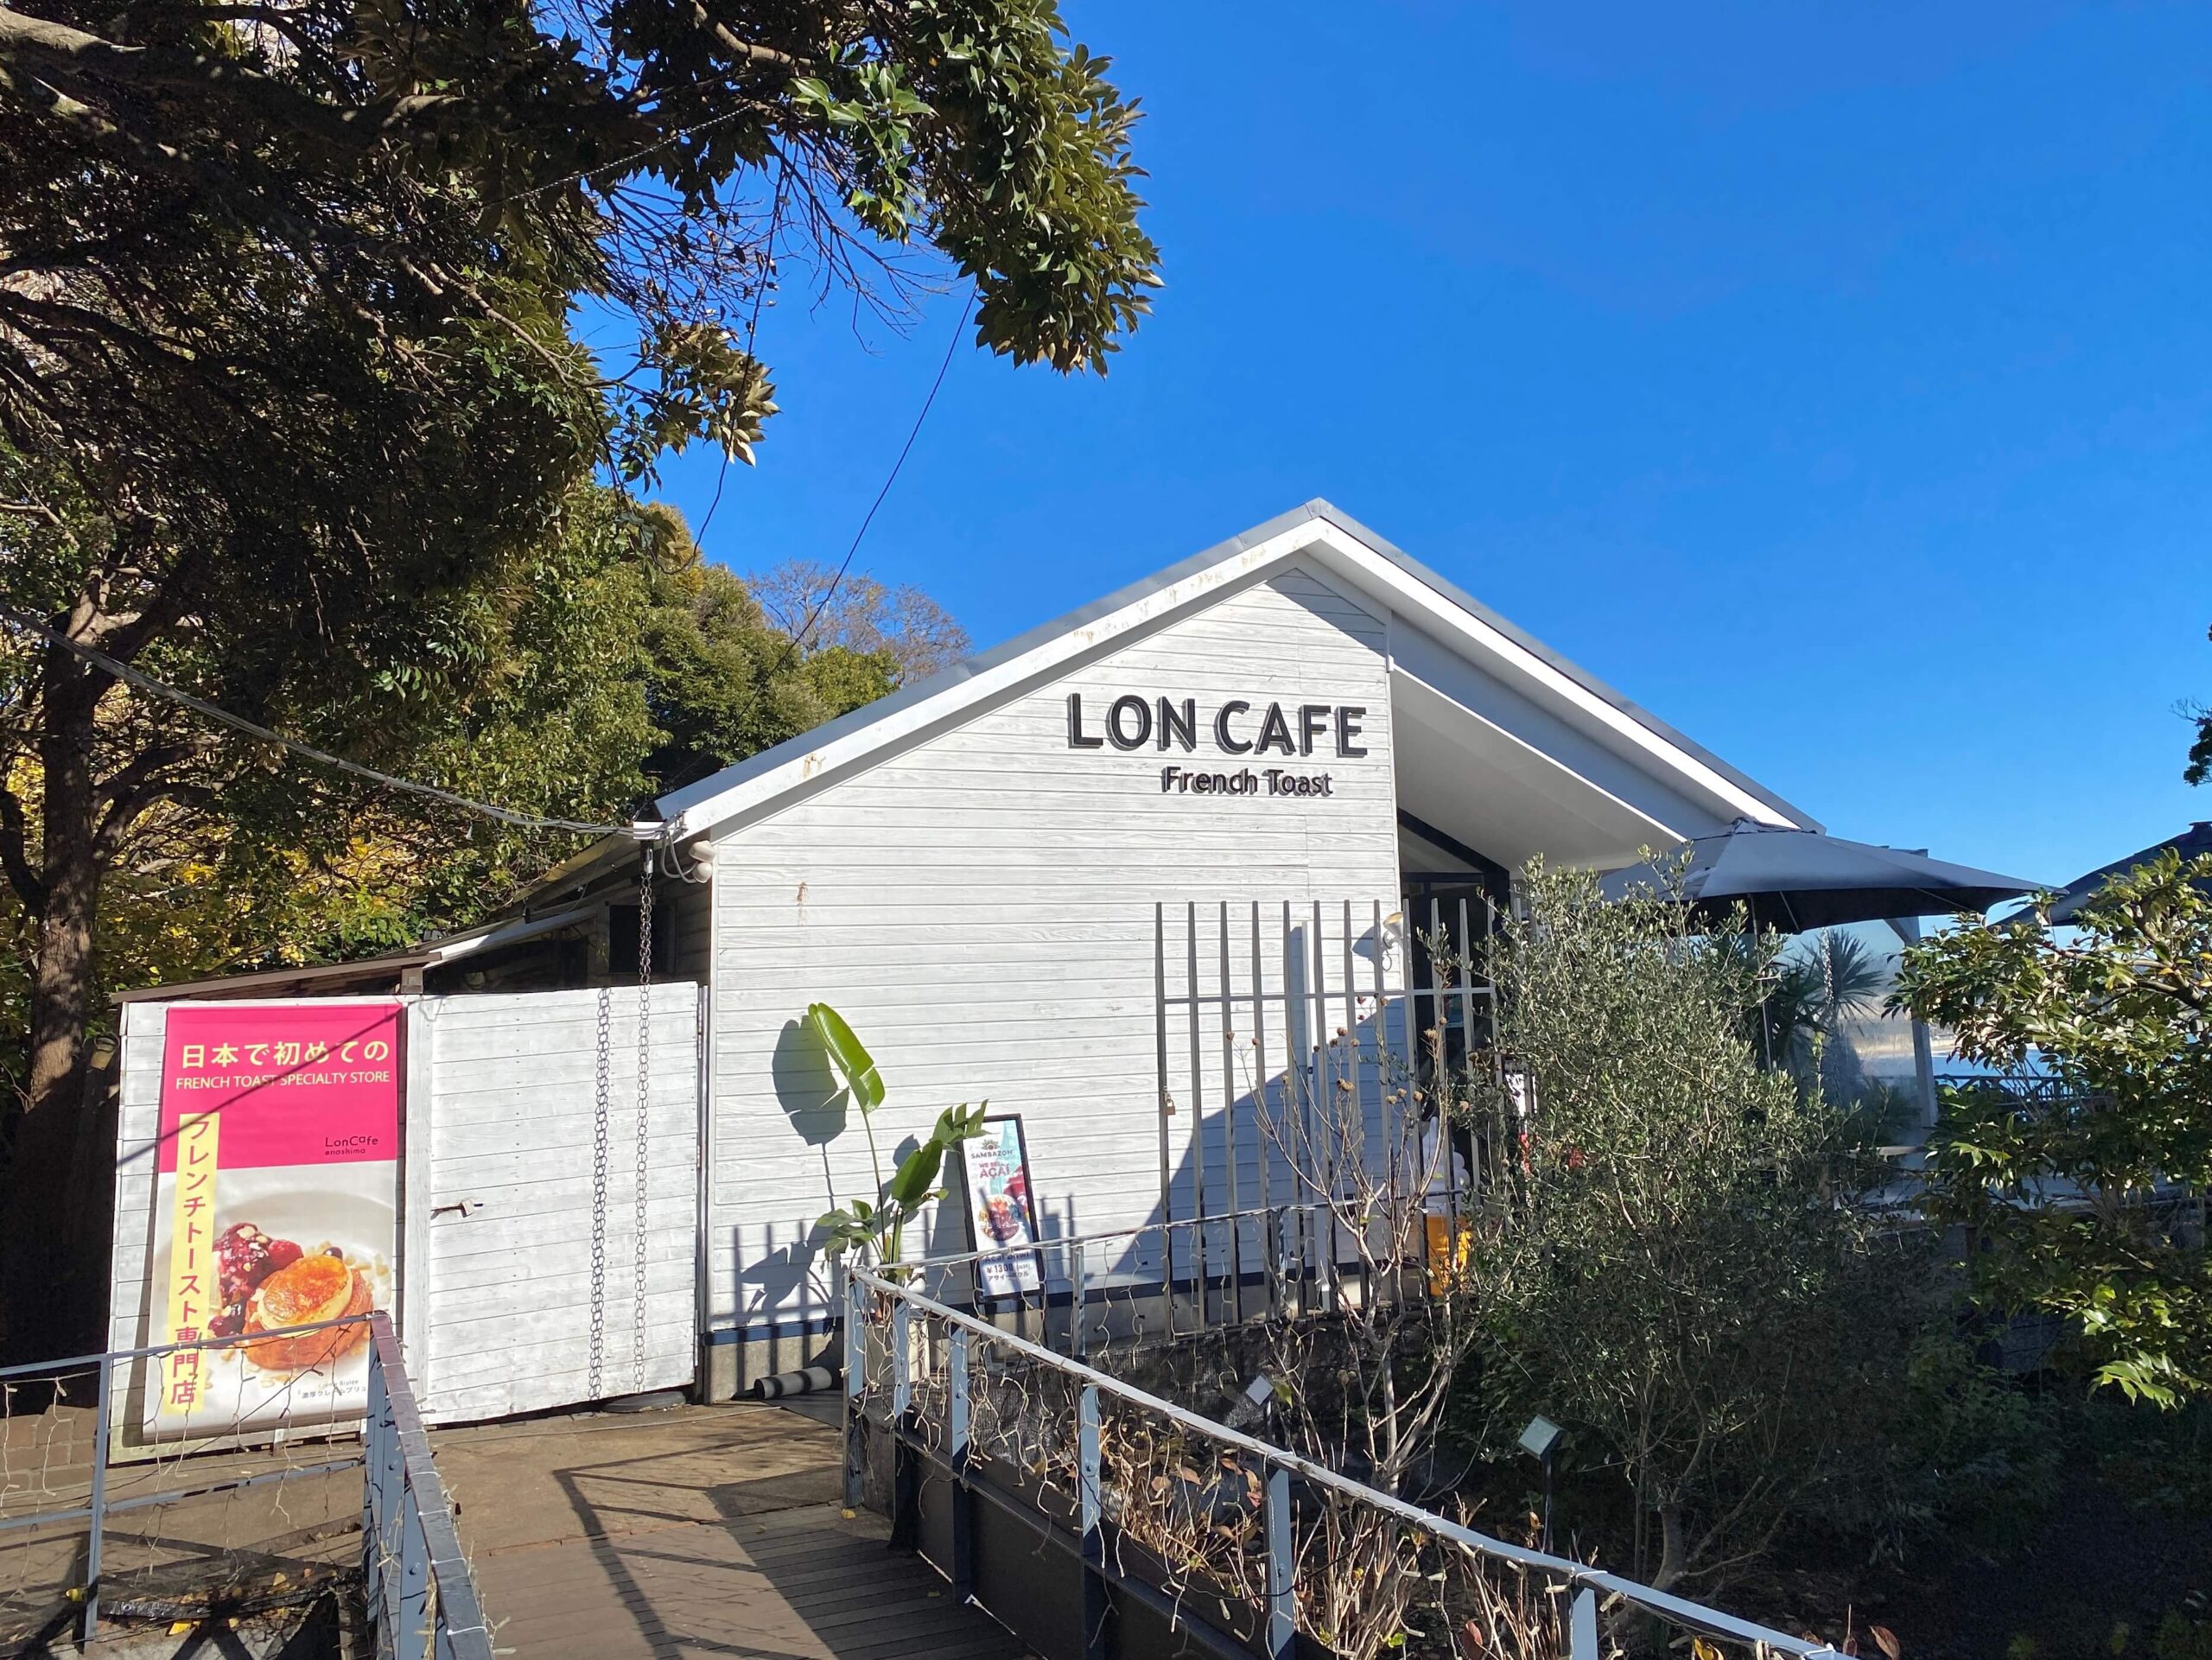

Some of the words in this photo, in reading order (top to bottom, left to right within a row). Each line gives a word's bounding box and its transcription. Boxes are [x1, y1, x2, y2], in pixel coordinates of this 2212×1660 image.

[1068, 692, 1197, 753] LON
[1214, 700, 1368, 758] CAFE
[1161, 766, 1258, 795] French
[1262, 768, 1333, 797] Toast
[181, 1040, 389, 1069] 日本で初めての
[175, 1076, 230, 1090] FRENCH
[233, 1074, 276, 1088] TOAST
[280, 1072, 348, 1086] SPECIALTY
[350, 1071, 390, 1084] STORE
[325, 1135, 378, 1147] LonCafe
[971, 1149, 1013, 1159] SAMBAZON
[170, 1121, 210, 1404] フレンチトースト専門店
